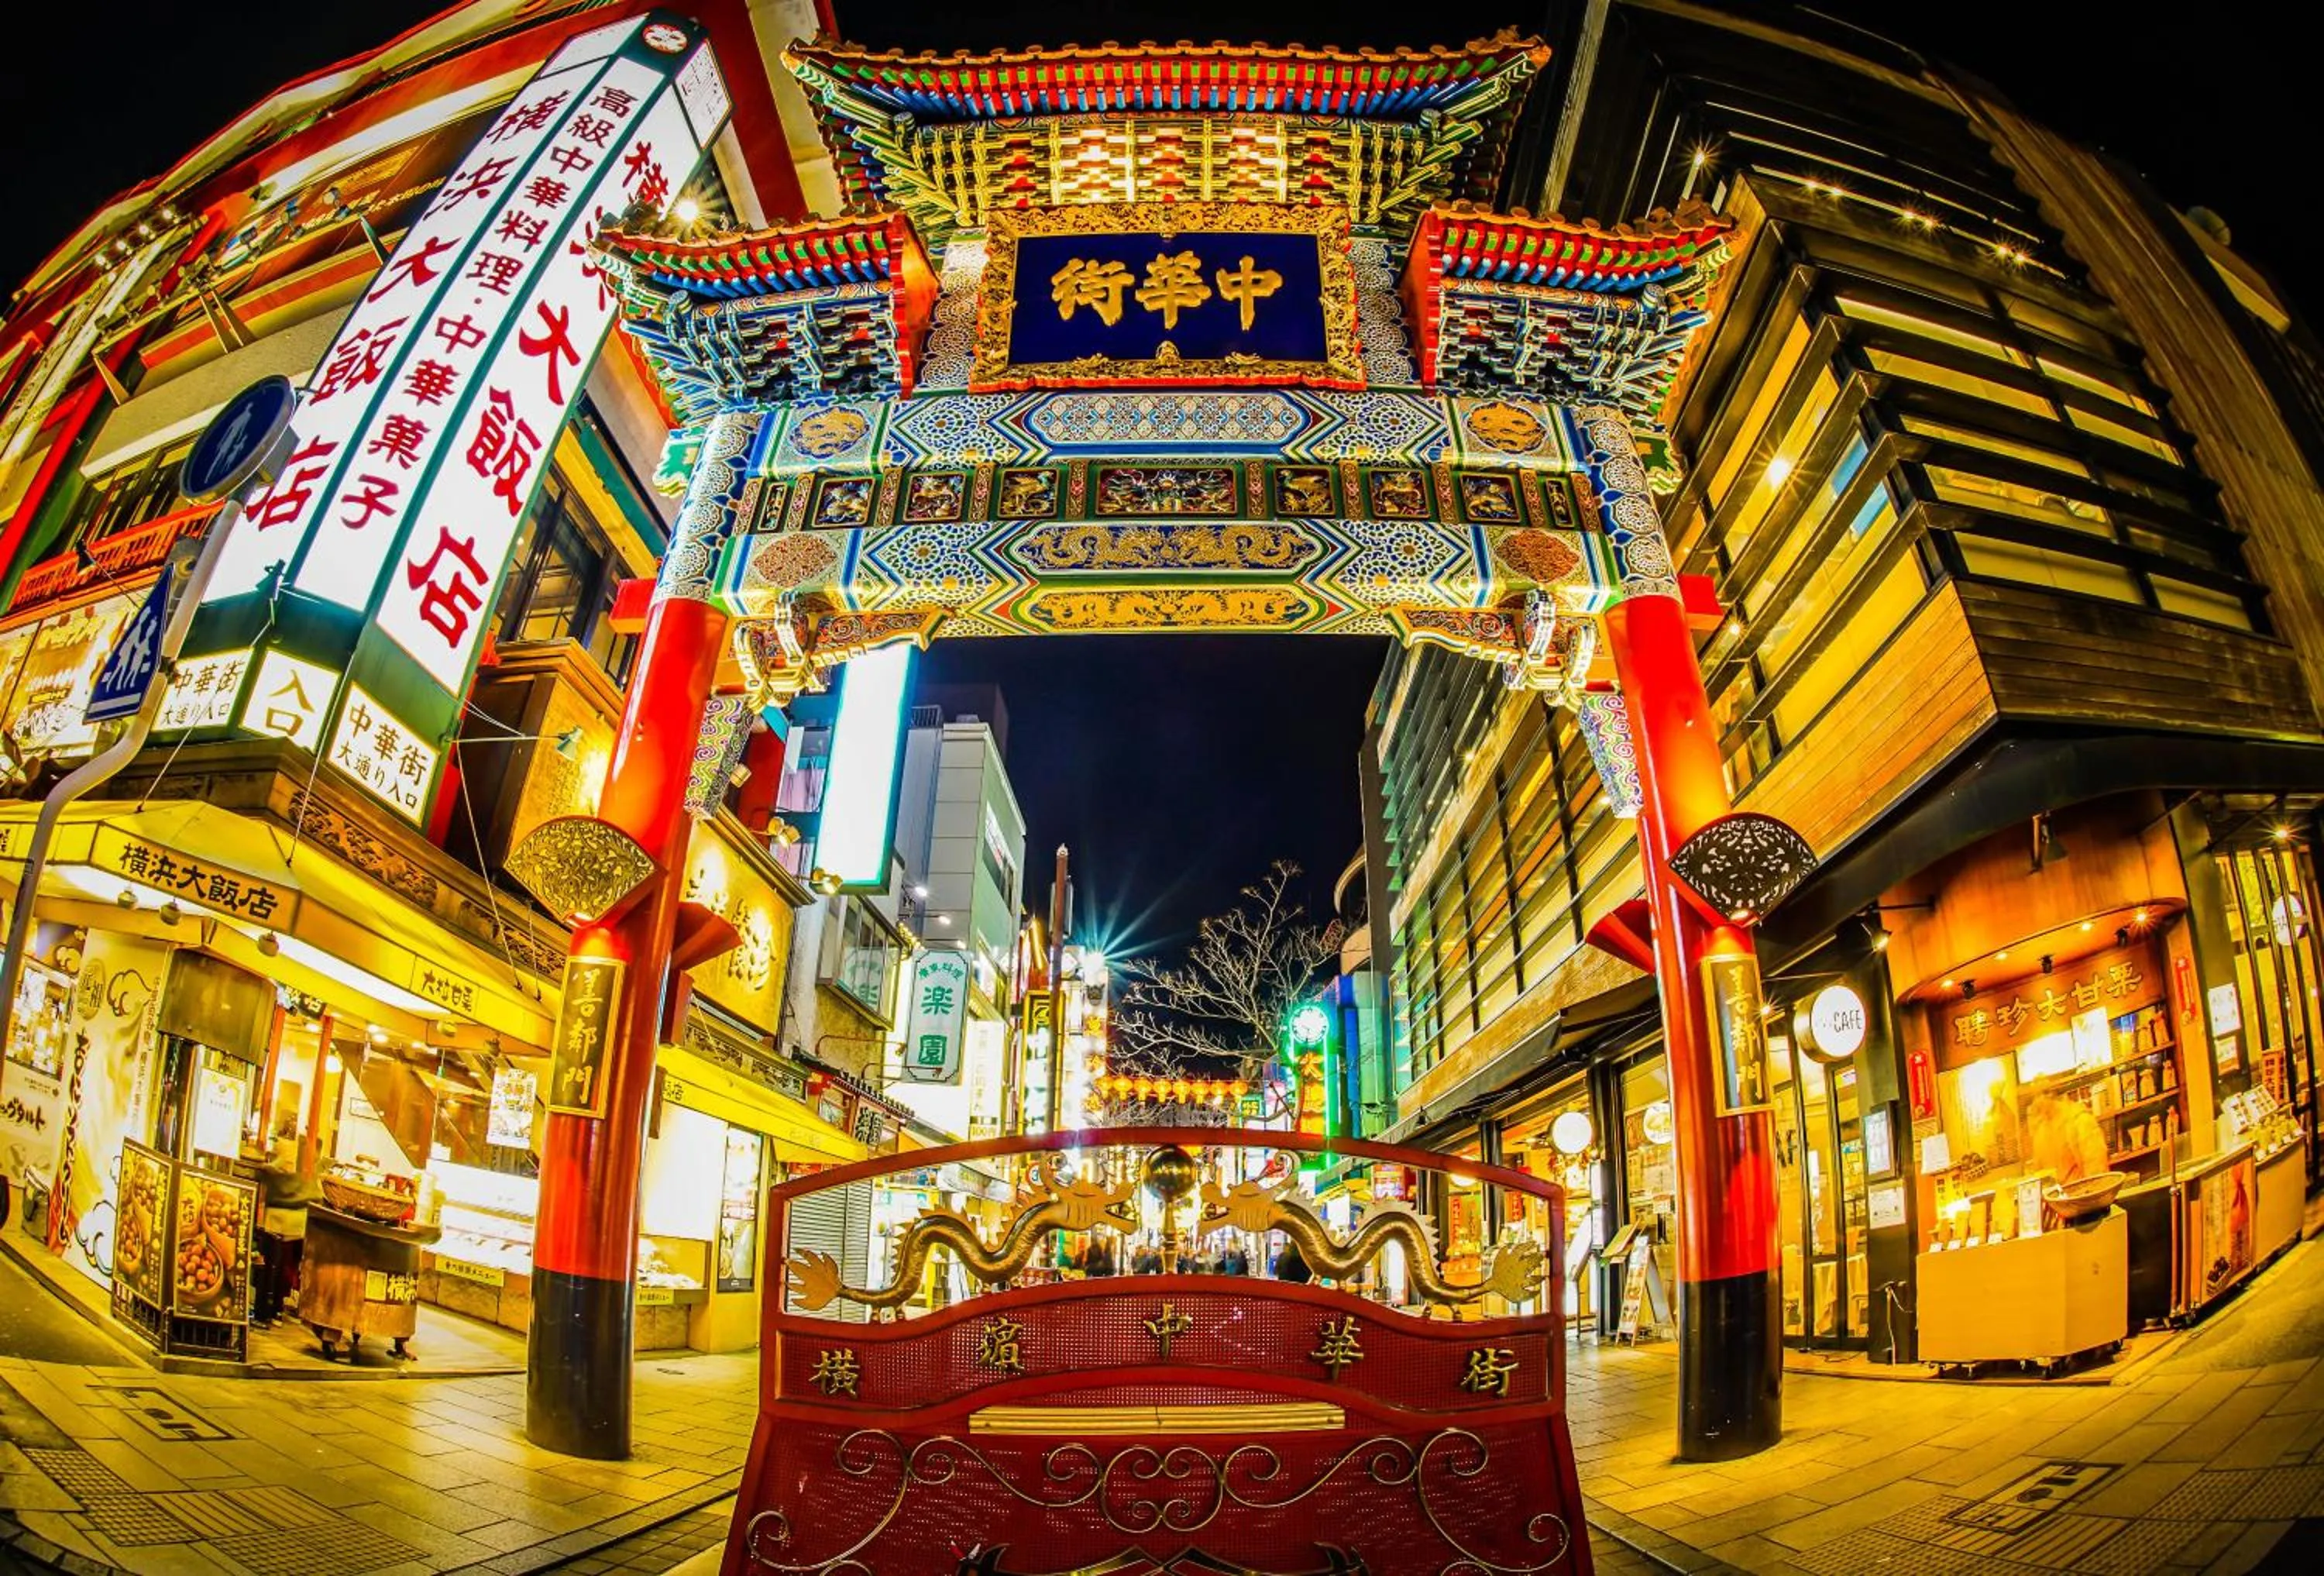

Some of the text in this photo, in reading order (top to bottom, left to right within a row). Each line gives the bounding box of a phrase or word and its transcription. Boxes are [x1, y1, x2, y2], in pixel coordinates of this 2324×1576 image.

[1050, 249, 1284, 332] 中華街
[160, 701, 232, 727] 大通り入口
[174, 659, 245, 694] 中華街
[264, 668, 316, 738] 入口
[335, 741, 418, 812] 大通り入口
[347, 702, 428, 789] 中華街
[118, 841, 278, 920] 横浜大飯店
[917, 985, 955, 1065] 楽園
[1833, 1008, 1863, 1034] CAFE
[1954, 961, 2144, 1047] 聘珍大甘栗
